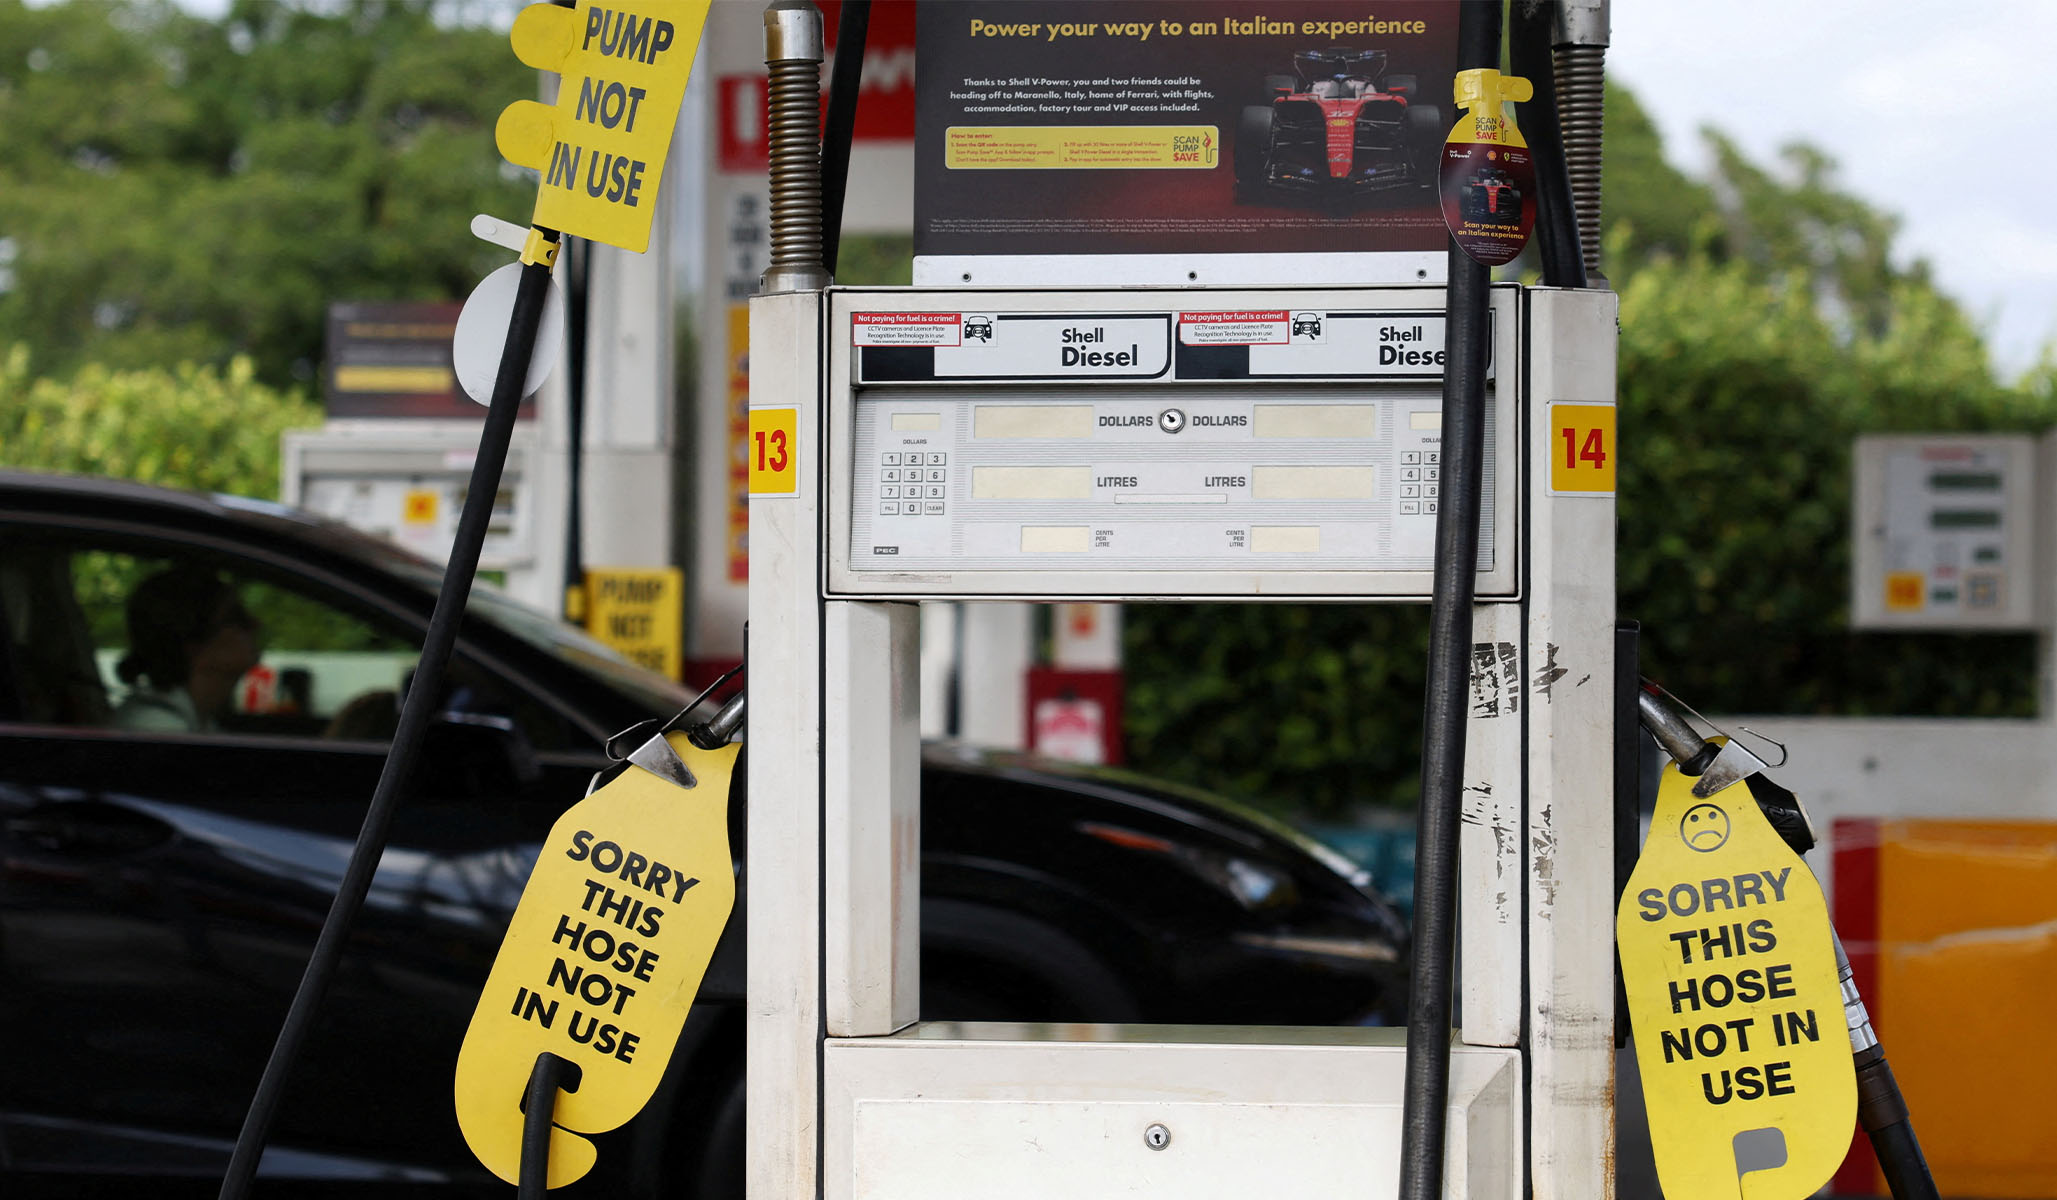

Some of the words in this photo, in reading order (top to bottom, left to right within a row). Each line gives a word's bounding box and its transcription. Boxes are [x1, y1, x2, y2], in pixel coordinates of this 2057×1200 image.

[582, 7, 674, 65] PUMP
[970, 19, 1041, 37] Power
[1047, 23, 1098, 41] your
[1104, 23, 1154, 41] way
[1160, 20, 1183, 35] to
[1189, 22, 1217, 35] an
[1224, 16, 1295, 35] Italian
[1302, 16, 1426, 39] experience
[950, 92, 986, 100] heading
[989, 91, 1001, 99] off
[1014, 91, 1062, 100] Maranello,
[1064, 91, 1087, 100] Italy,
[1089, 91, 1113, 99] home
[1116, 91, 1125, 99] of
[1127, 91, 1159, 100] Ferrari,
[1184, 90, 1214, 99] flights,
[964, 78, 995, 86] Thanks
[1008, 78, 1029, 86] Shell
[1032, 78, 1070, 86] V-Power,
[1073, 79, 1090, 87] you
[1131, 77, 1161, 85] friends
[1163, 77, 1187, 85] could
[576, 76, 646, 132] NOT
[964, 104, 1037, 113] accommodation,
[1039, 104, 1070, 113] factory
[1173, 136, 1199, 144] SCAN
[1173, 144, 1199, 152] PUMP
[546, 141, 581, 191] IN
[587, 151, 646, 207] USE
[1198, 314, 1222, 322] paying
[1379, 327, 1422, 341] Shell
[1062, 328, 1103, 342] Shell
[1062, 344, 1137, 366] Diesel
[1379, 345, 1444, 365] Diese
[1099, 416, 1153, 426] DOLLARS
[1193, 416, 1247, 426] DOLLARS
[756, 430, 787, 472] 13
[1563, 428, 1605, 469] 14
[1097, 477, 1137, 487] LITRES
[1205, 477, 1245, 487] LITRES
[566, 830, 700, 904] SORRY
[580, 879, 665, 938] THIS
[1638, 867, 1792, 922] SORRY
[552, 914, 659, 983] HOSE
[1670, 919, 1777, 964] THIS
[547, 957, 636, 1016] NOT
[1669, 964, 1796, 1014] HOSE
[511, 986, 560, 1030] IN
[567, 1011, 641, 1064] USE
[1660, 1018, 1754, 1063] NOT
[1772, 1009, 1820, 1047] IN
[1702, 1061, 1795, 1105] USE
